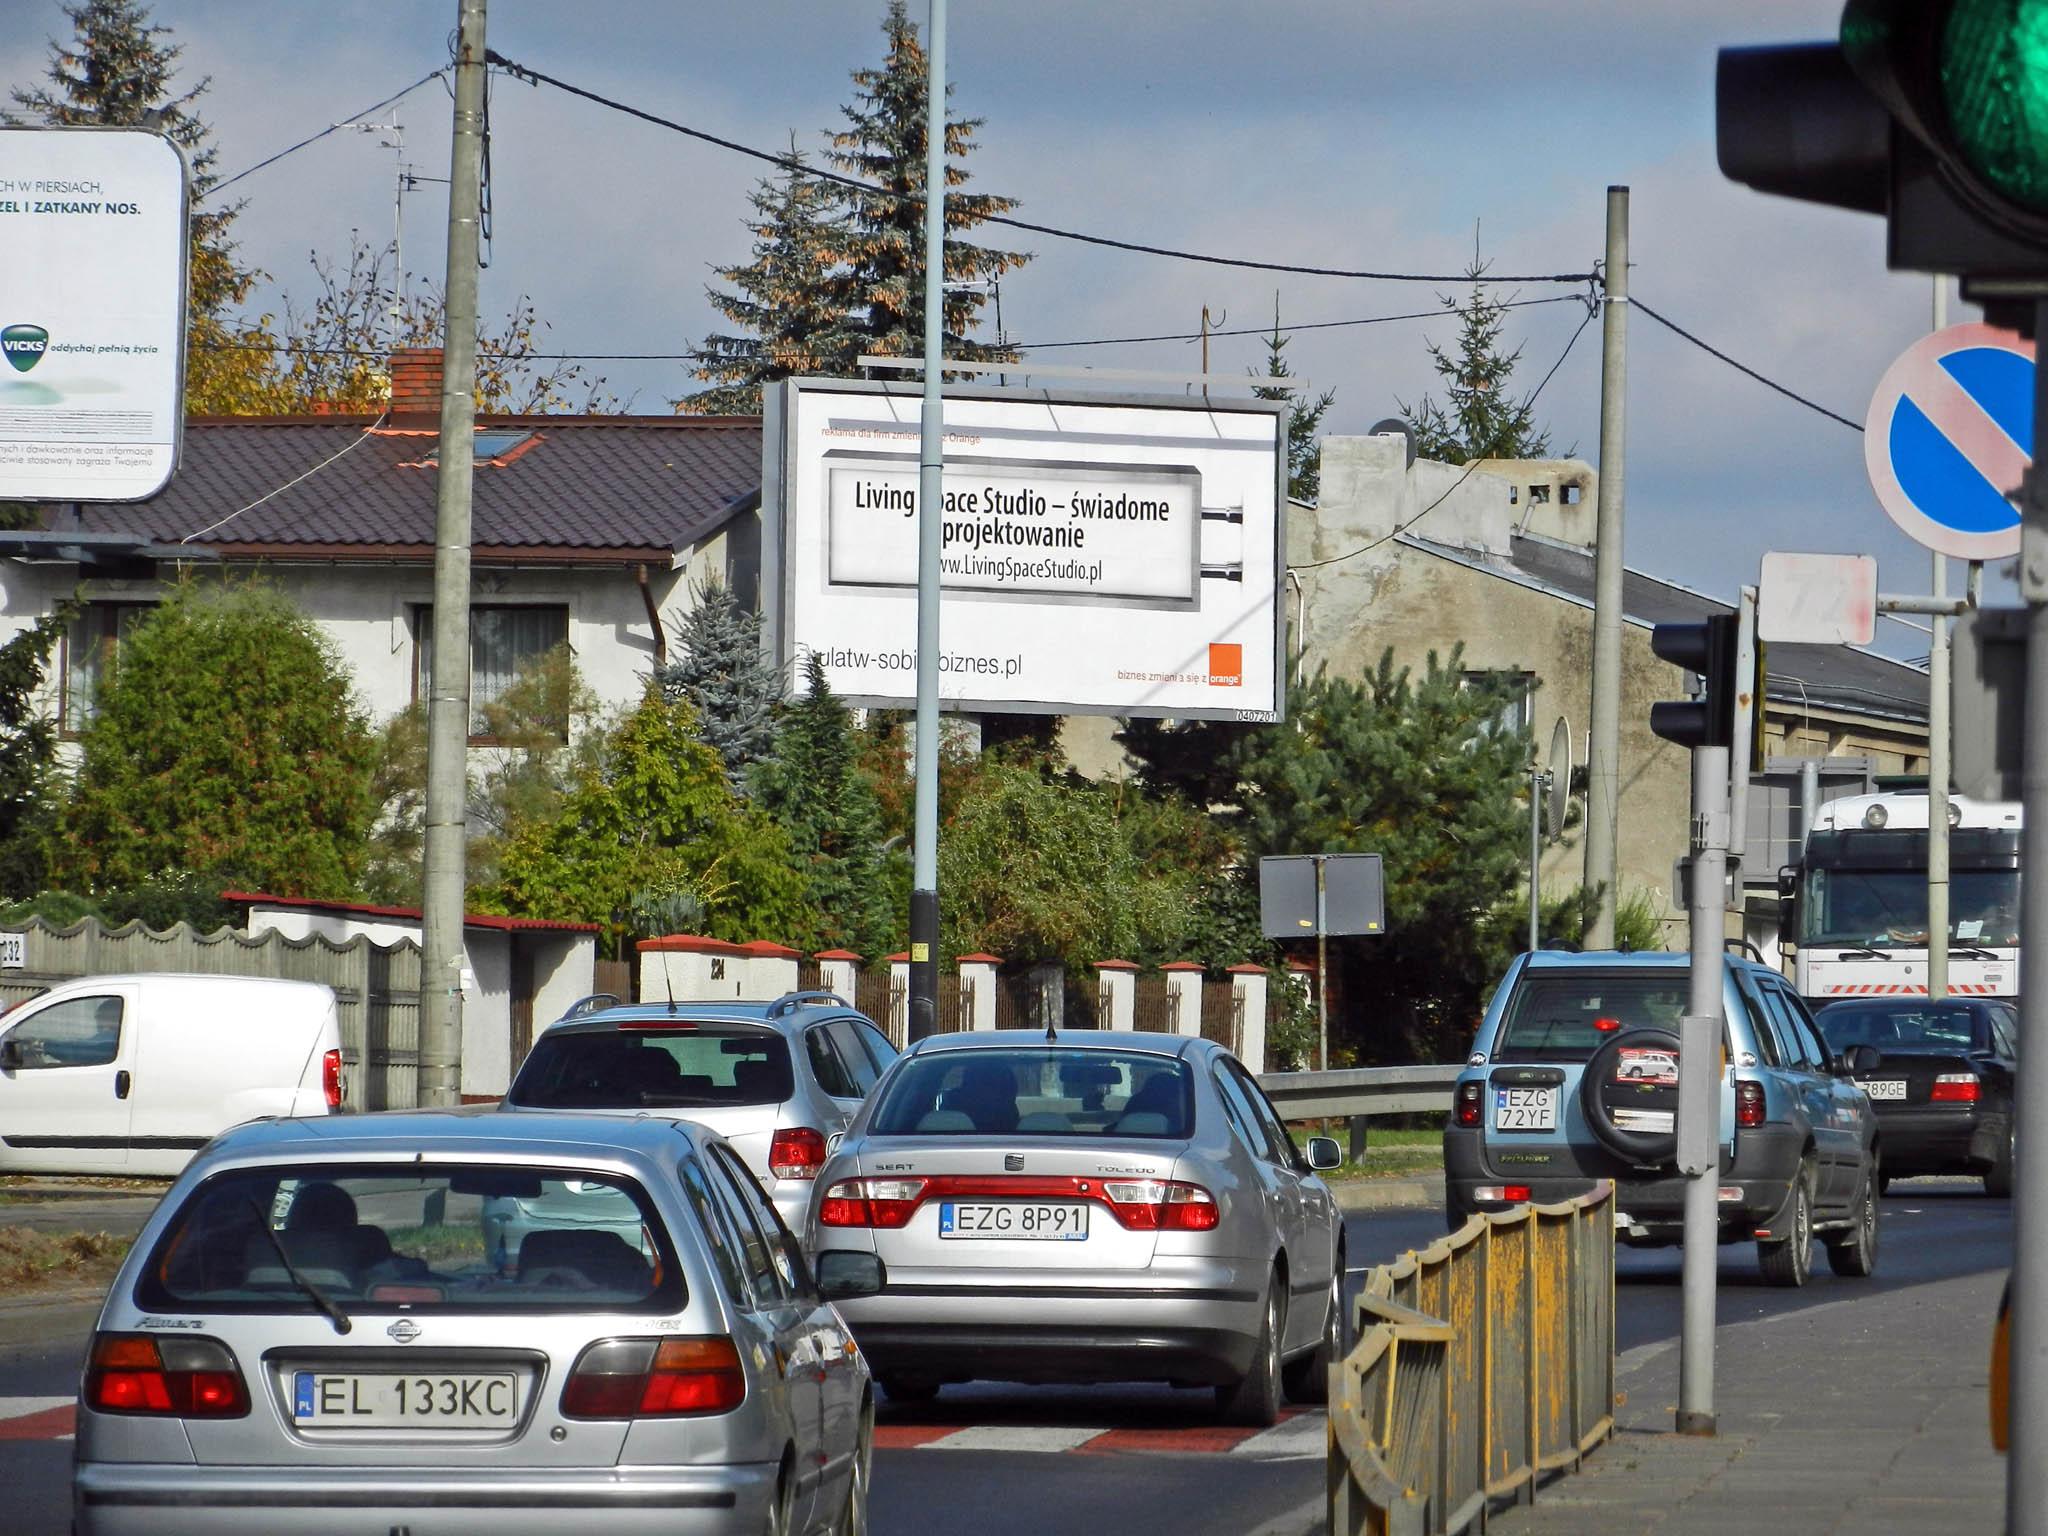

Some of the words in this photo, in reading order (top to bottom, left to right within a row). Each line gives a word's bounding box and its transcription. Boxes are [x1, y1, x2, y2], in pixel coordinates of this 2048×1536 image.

[18, 181, 32, 192] W
[35, 181, 104, 195] PIERSIACH,
[25, 201, 29, 213] I
[34, 201, 102, 214] ZATKANY
[105, 203, 141, 215] NOS.
[4, 340, 44, 352] VICKS
[51, 343, 96, 354] oddychaj
[97, 344, 130, 355] pełnią
[133, 344, 158, 355] życia
[821, 427, 856, 437] reklama
[858, 429, 871, 439] dla
[873, 429, 890, 439] firm
[950, 432, 980, 445] Orange
[856, 481, 915, 517] Living
[941, 491, 978, 513] ace
[983, 487, 1046, 516] Studio
[1071, 491, 1169, 521] świadome
[943, 517, 1084, 550] projektowanie
[940, 554, 1102, 585] ww.LivingSpaceStudio.pl
[1117, 670, 1147, 680] biznes
[1210, 675, 1239, 685] orange
[1509, 1090, 1548, 1107] EZG
[1503, 1110, 1550, 1126] 72YF
[958, 1207, 1012, 1230] EZG
[1022, 1208, 1080, 1231] 8P91
[299, 1401, 311, 1411] PL
[321, 1379, 372, 1414] EL
[395, 1380, 507, 1416] 133KC
